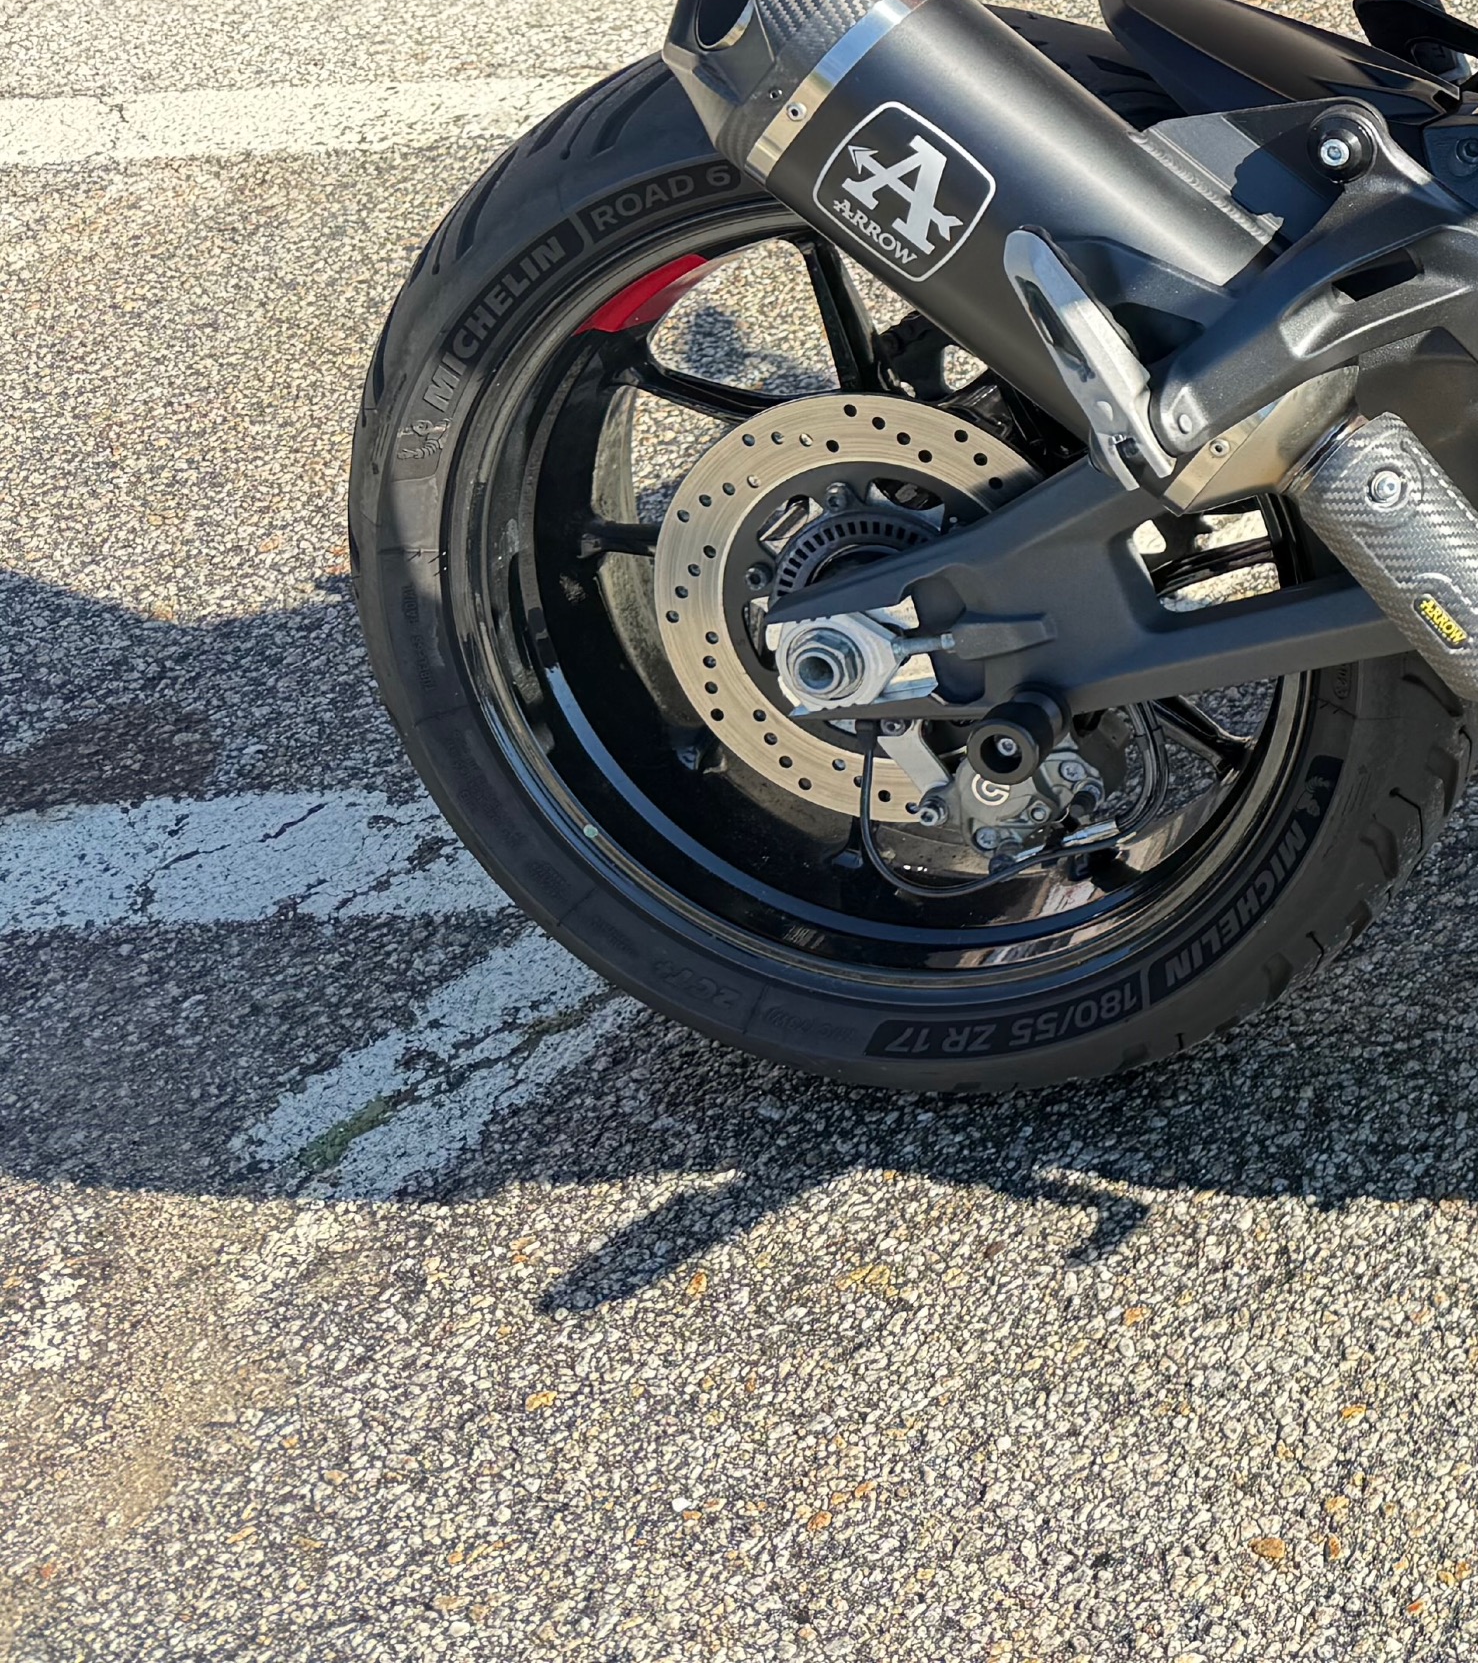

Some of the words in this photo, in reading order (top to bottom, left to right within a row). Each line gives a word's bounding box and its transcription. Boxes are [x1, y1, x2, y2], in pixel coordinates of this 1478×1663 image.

[833, 199, 917, 264] ARROW
[423, 236, 567, 412] MICHELIN
[590, 175, 694, 231] ROAD
[705, 165, 731, 186] 6
[1420, 600, 1467, 644] ARROW
[1164, 819, 1309, 986] MICHELIN
[886, 1025, 933, 1053] 17
[941, 1024, 998, 1052] ZR
[1009, 984, 1138, 1048] 180/55
